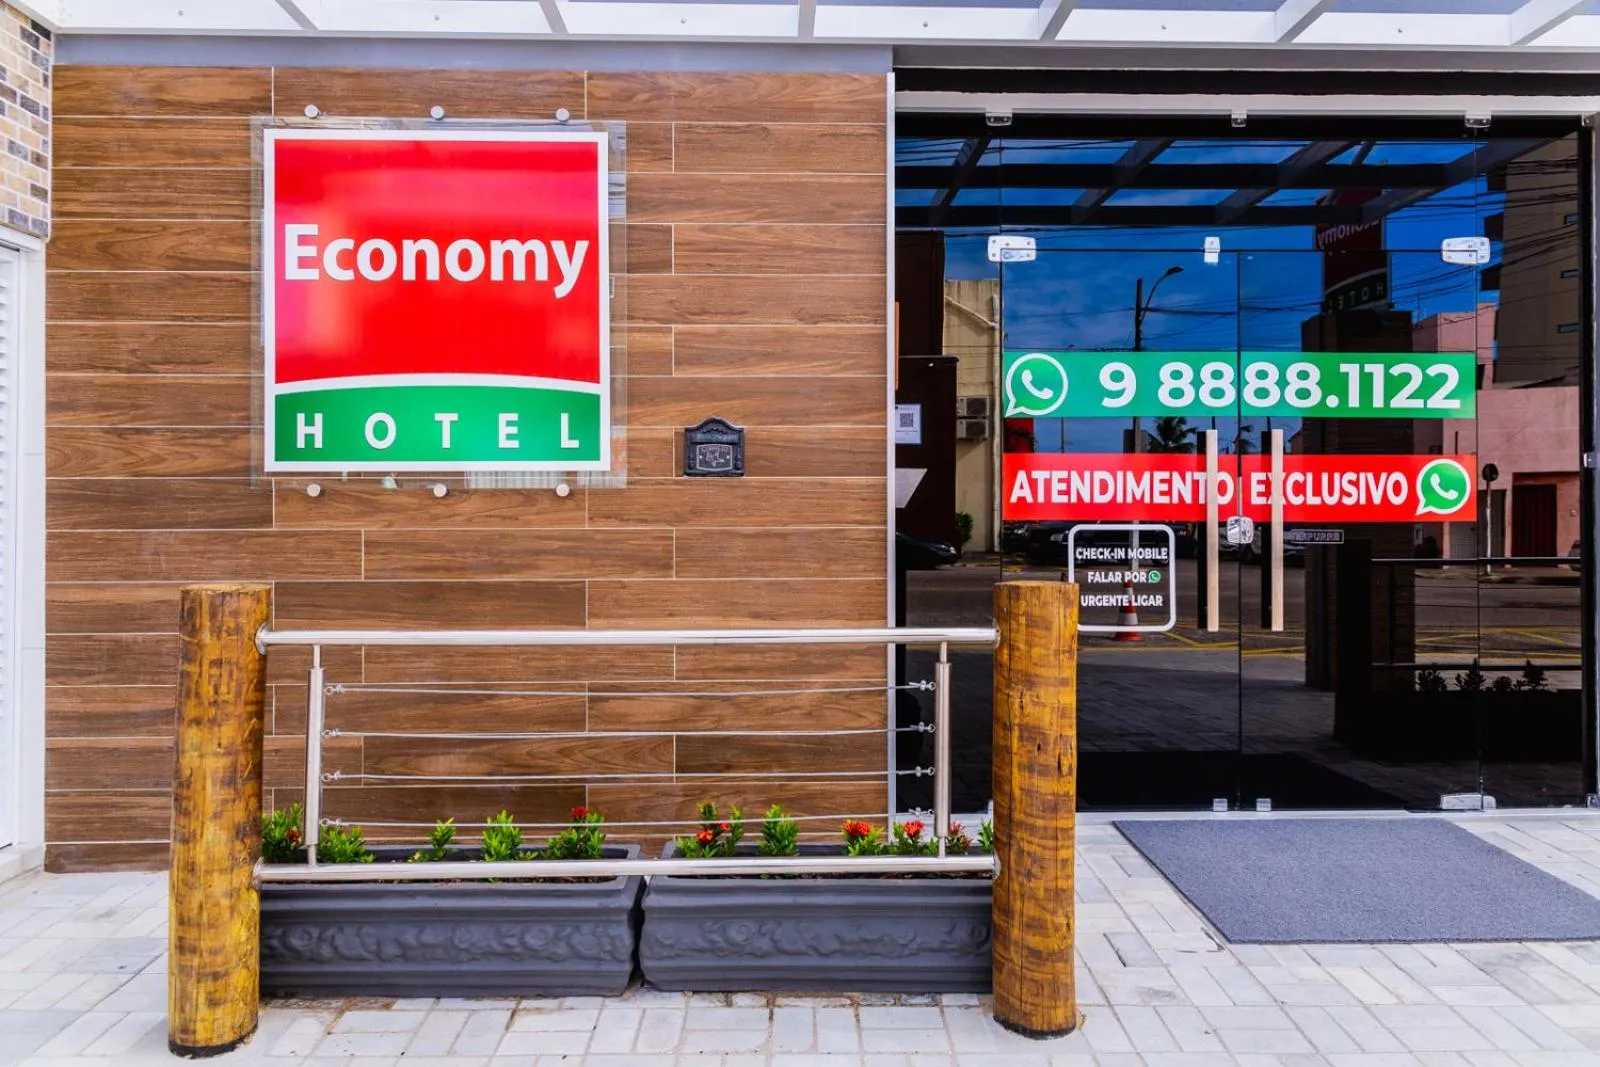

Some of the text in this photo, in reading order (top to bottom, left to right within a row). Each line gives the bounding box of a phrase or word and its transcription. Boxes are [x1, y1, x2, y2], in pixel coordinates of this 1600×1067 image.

[285, 223, 589, 299] Economy
[1100, 361, 1461, 410] 9 8888.1122
[296, 412, 580, 450] HOTEL
[1010, 470, 1236, 505] ATENDIMENTO
[1075, 546, 1168, 560] CHECK-IN MOBILE
[1087, 571, 1148, 583] FALAR POR
[1080, 594, 1164, 608] URGENTE LIGAR
